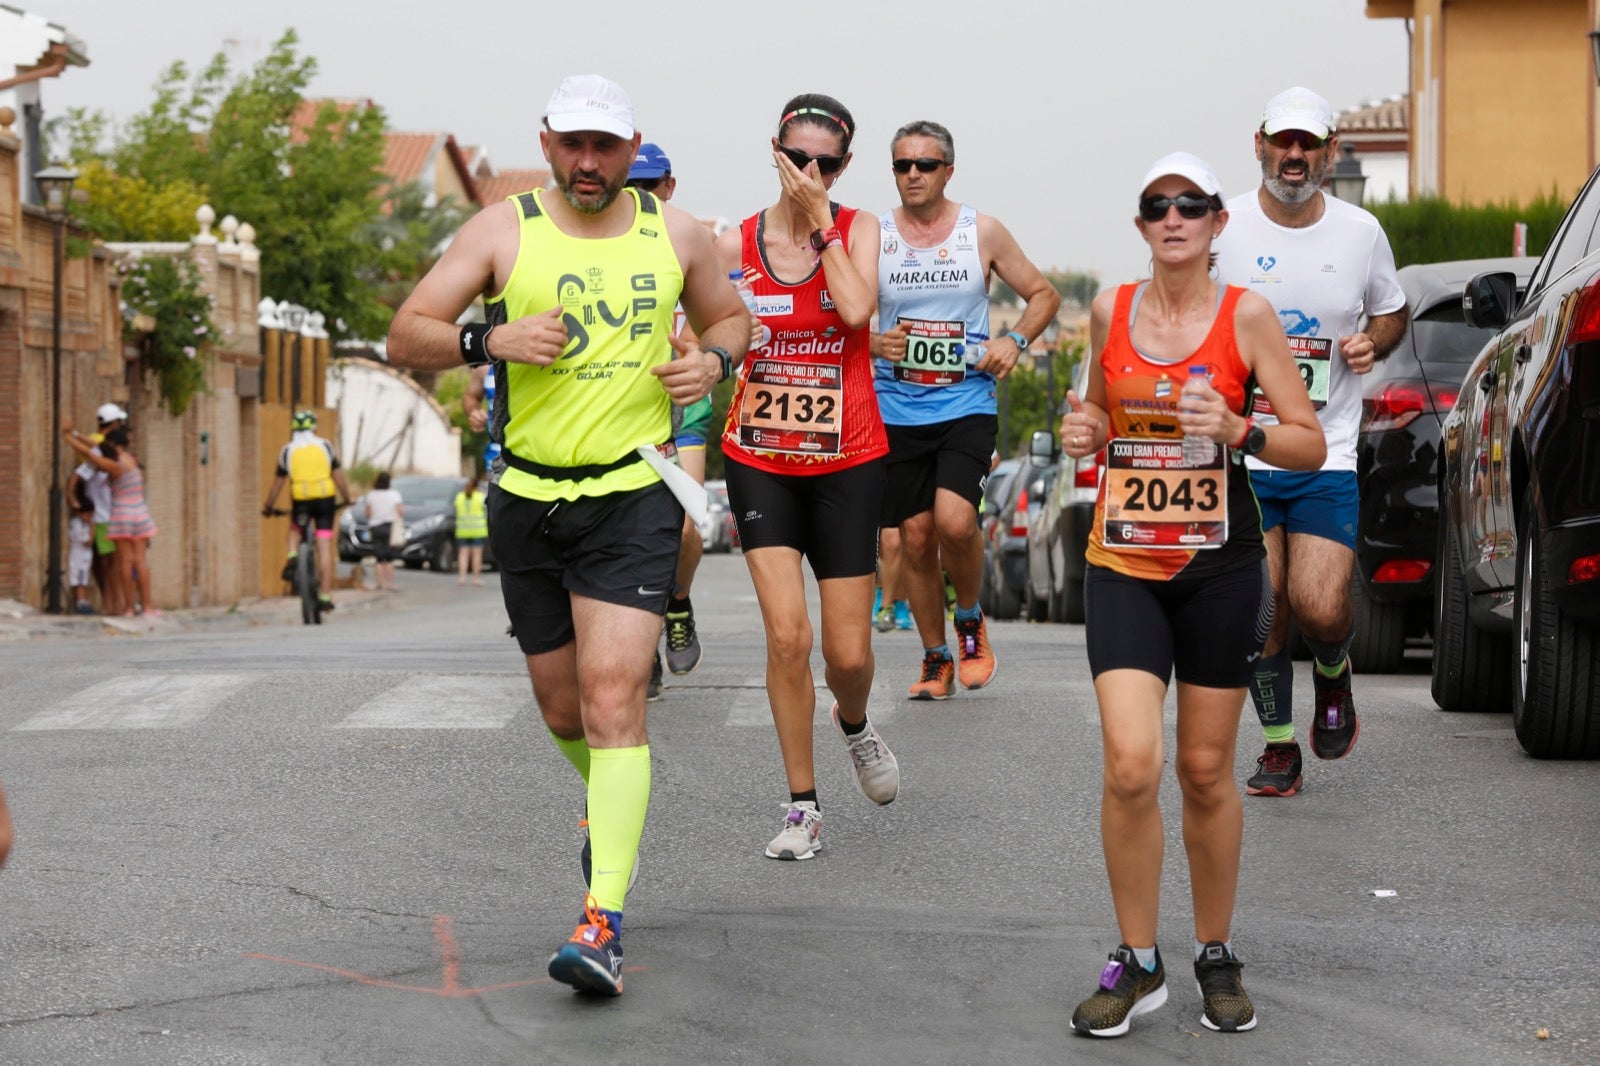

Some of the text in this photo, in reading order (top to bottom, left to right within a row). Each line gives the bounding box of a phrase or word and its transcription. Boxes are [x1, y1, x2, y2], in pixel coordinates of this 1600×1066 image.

[889, 269, 968, 284] MARACENA
[777, 330, 814, 340] Clínicas
[766, 363, 782, 375] GRAN
[783, 364, 806, 377] PREMIO
[807, 366, 815, 377] DE
[816, 367, 836, 379] FONDO
[753, 390, 835, 425] 2132
[1134, 444, 1153, 457] GRAN
[1154, 445, 1182, 458] PREMIO
[1123, 477, 1219, 512] 2043
